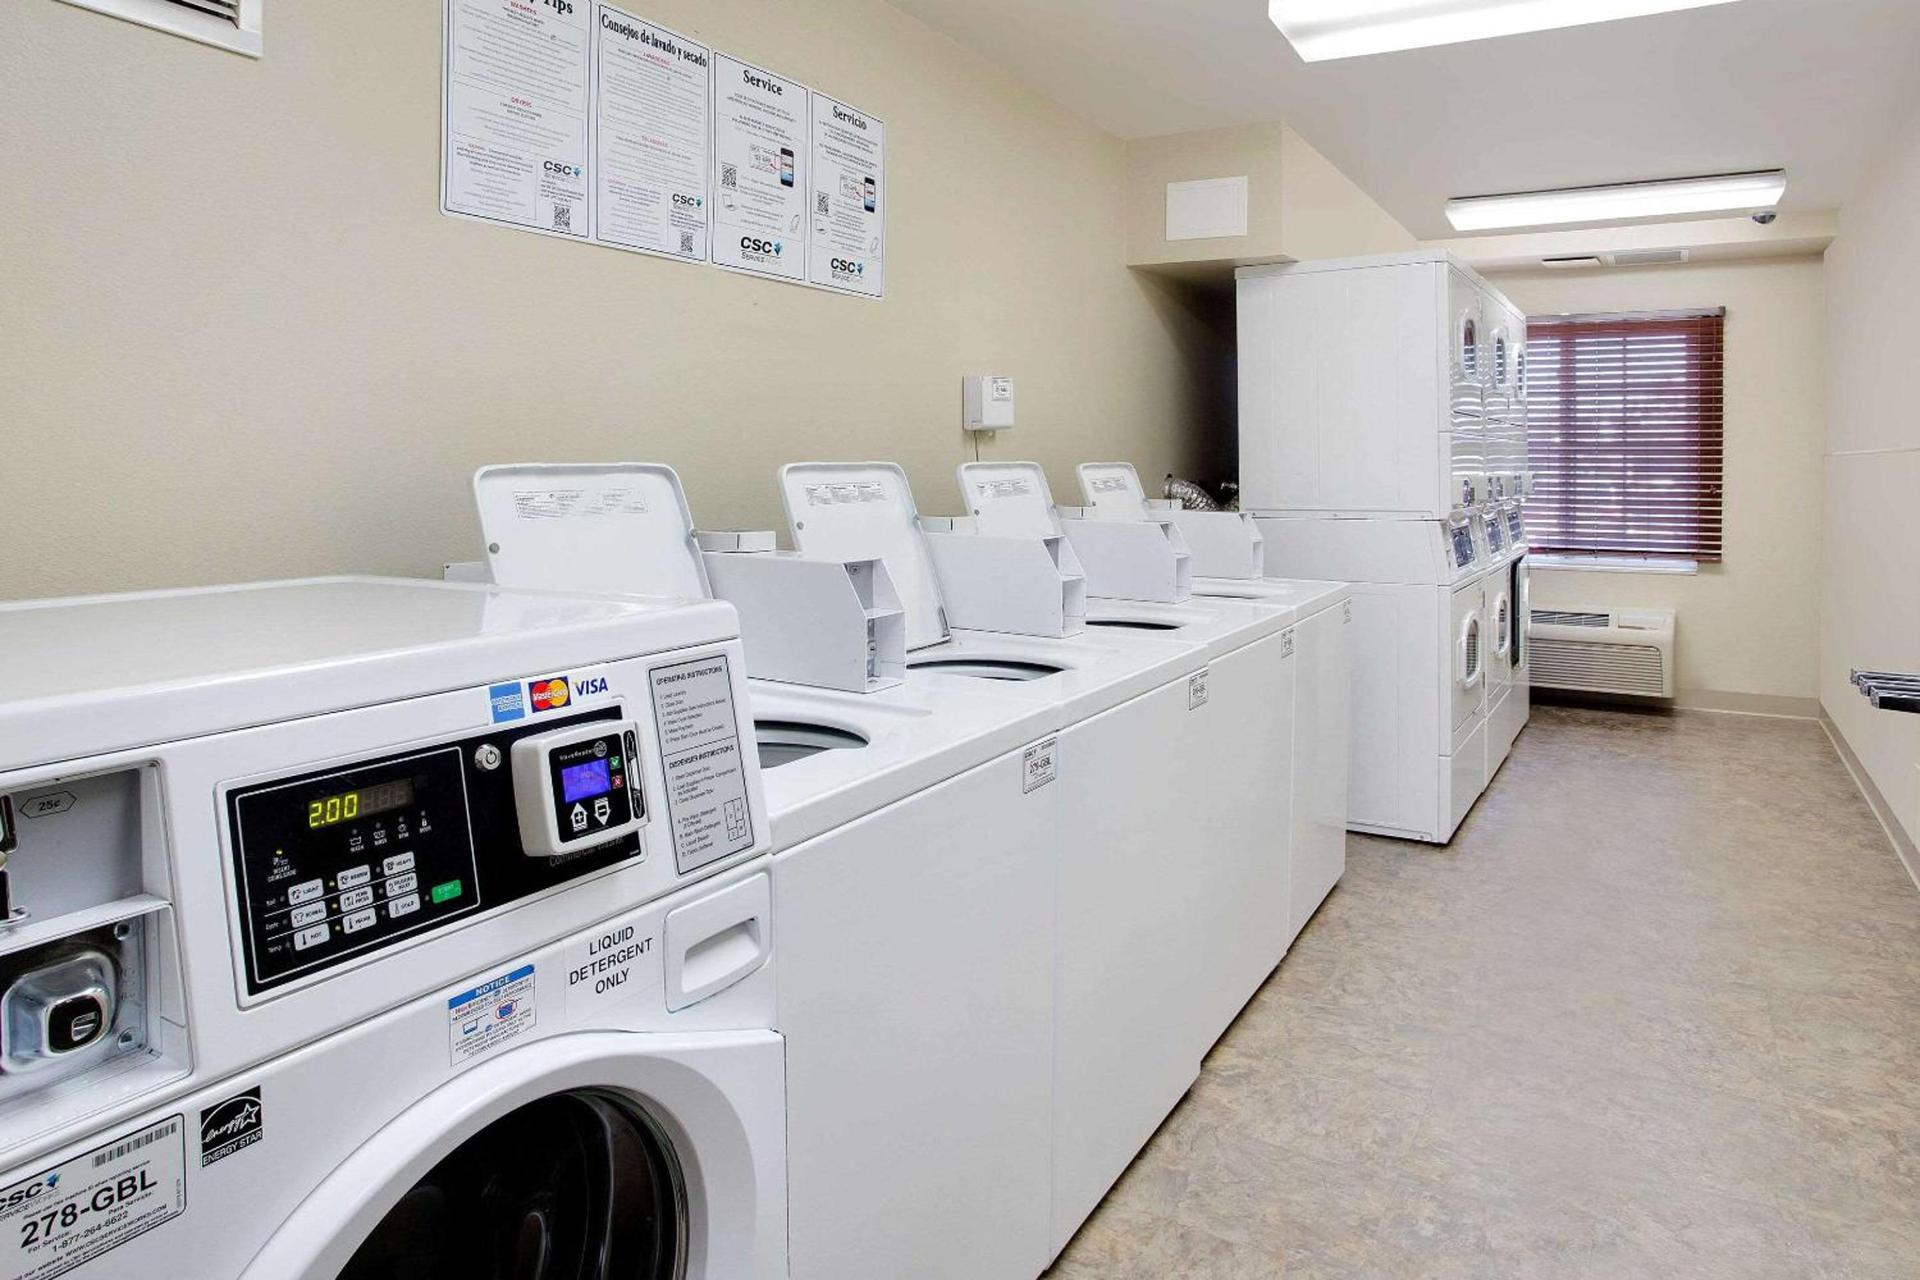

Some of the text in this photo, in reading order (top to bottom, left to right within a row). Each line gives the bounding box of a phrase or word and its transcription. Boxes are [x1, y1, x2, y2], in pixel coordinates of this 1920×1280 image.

[601, 14, 639, 40] Consejos
[640, 29, 650, 45] de
[651, 33, 676, 55] lavado
[677, 47, 682, 60] y
[683, 50, 707, 67] secado
[743, 69, 783, 96] Service
[832, 105, 867, 131] Servicio
[543, 160, 572, 175] CSC
[672, 193, 695, 206] CSC
[740, 236, 772, 254] CSC
[831, 257, 856, 273] CSC
[576, 677, 608, 696] VISA
[309, 794, 358, 828] 2.00
[589, 926, 634, 956] LIQUID
[569, 937, 653, 985] DETERGENT
[475, 975, 511, 997] NOTICE
[595, 967, 629, 994] ONLY
[203, 1131, 262, 1166] ENERGY STAR
[20, 1169, 158, 1249] 278-GBL
[28, 1244, 41, 1253] For
